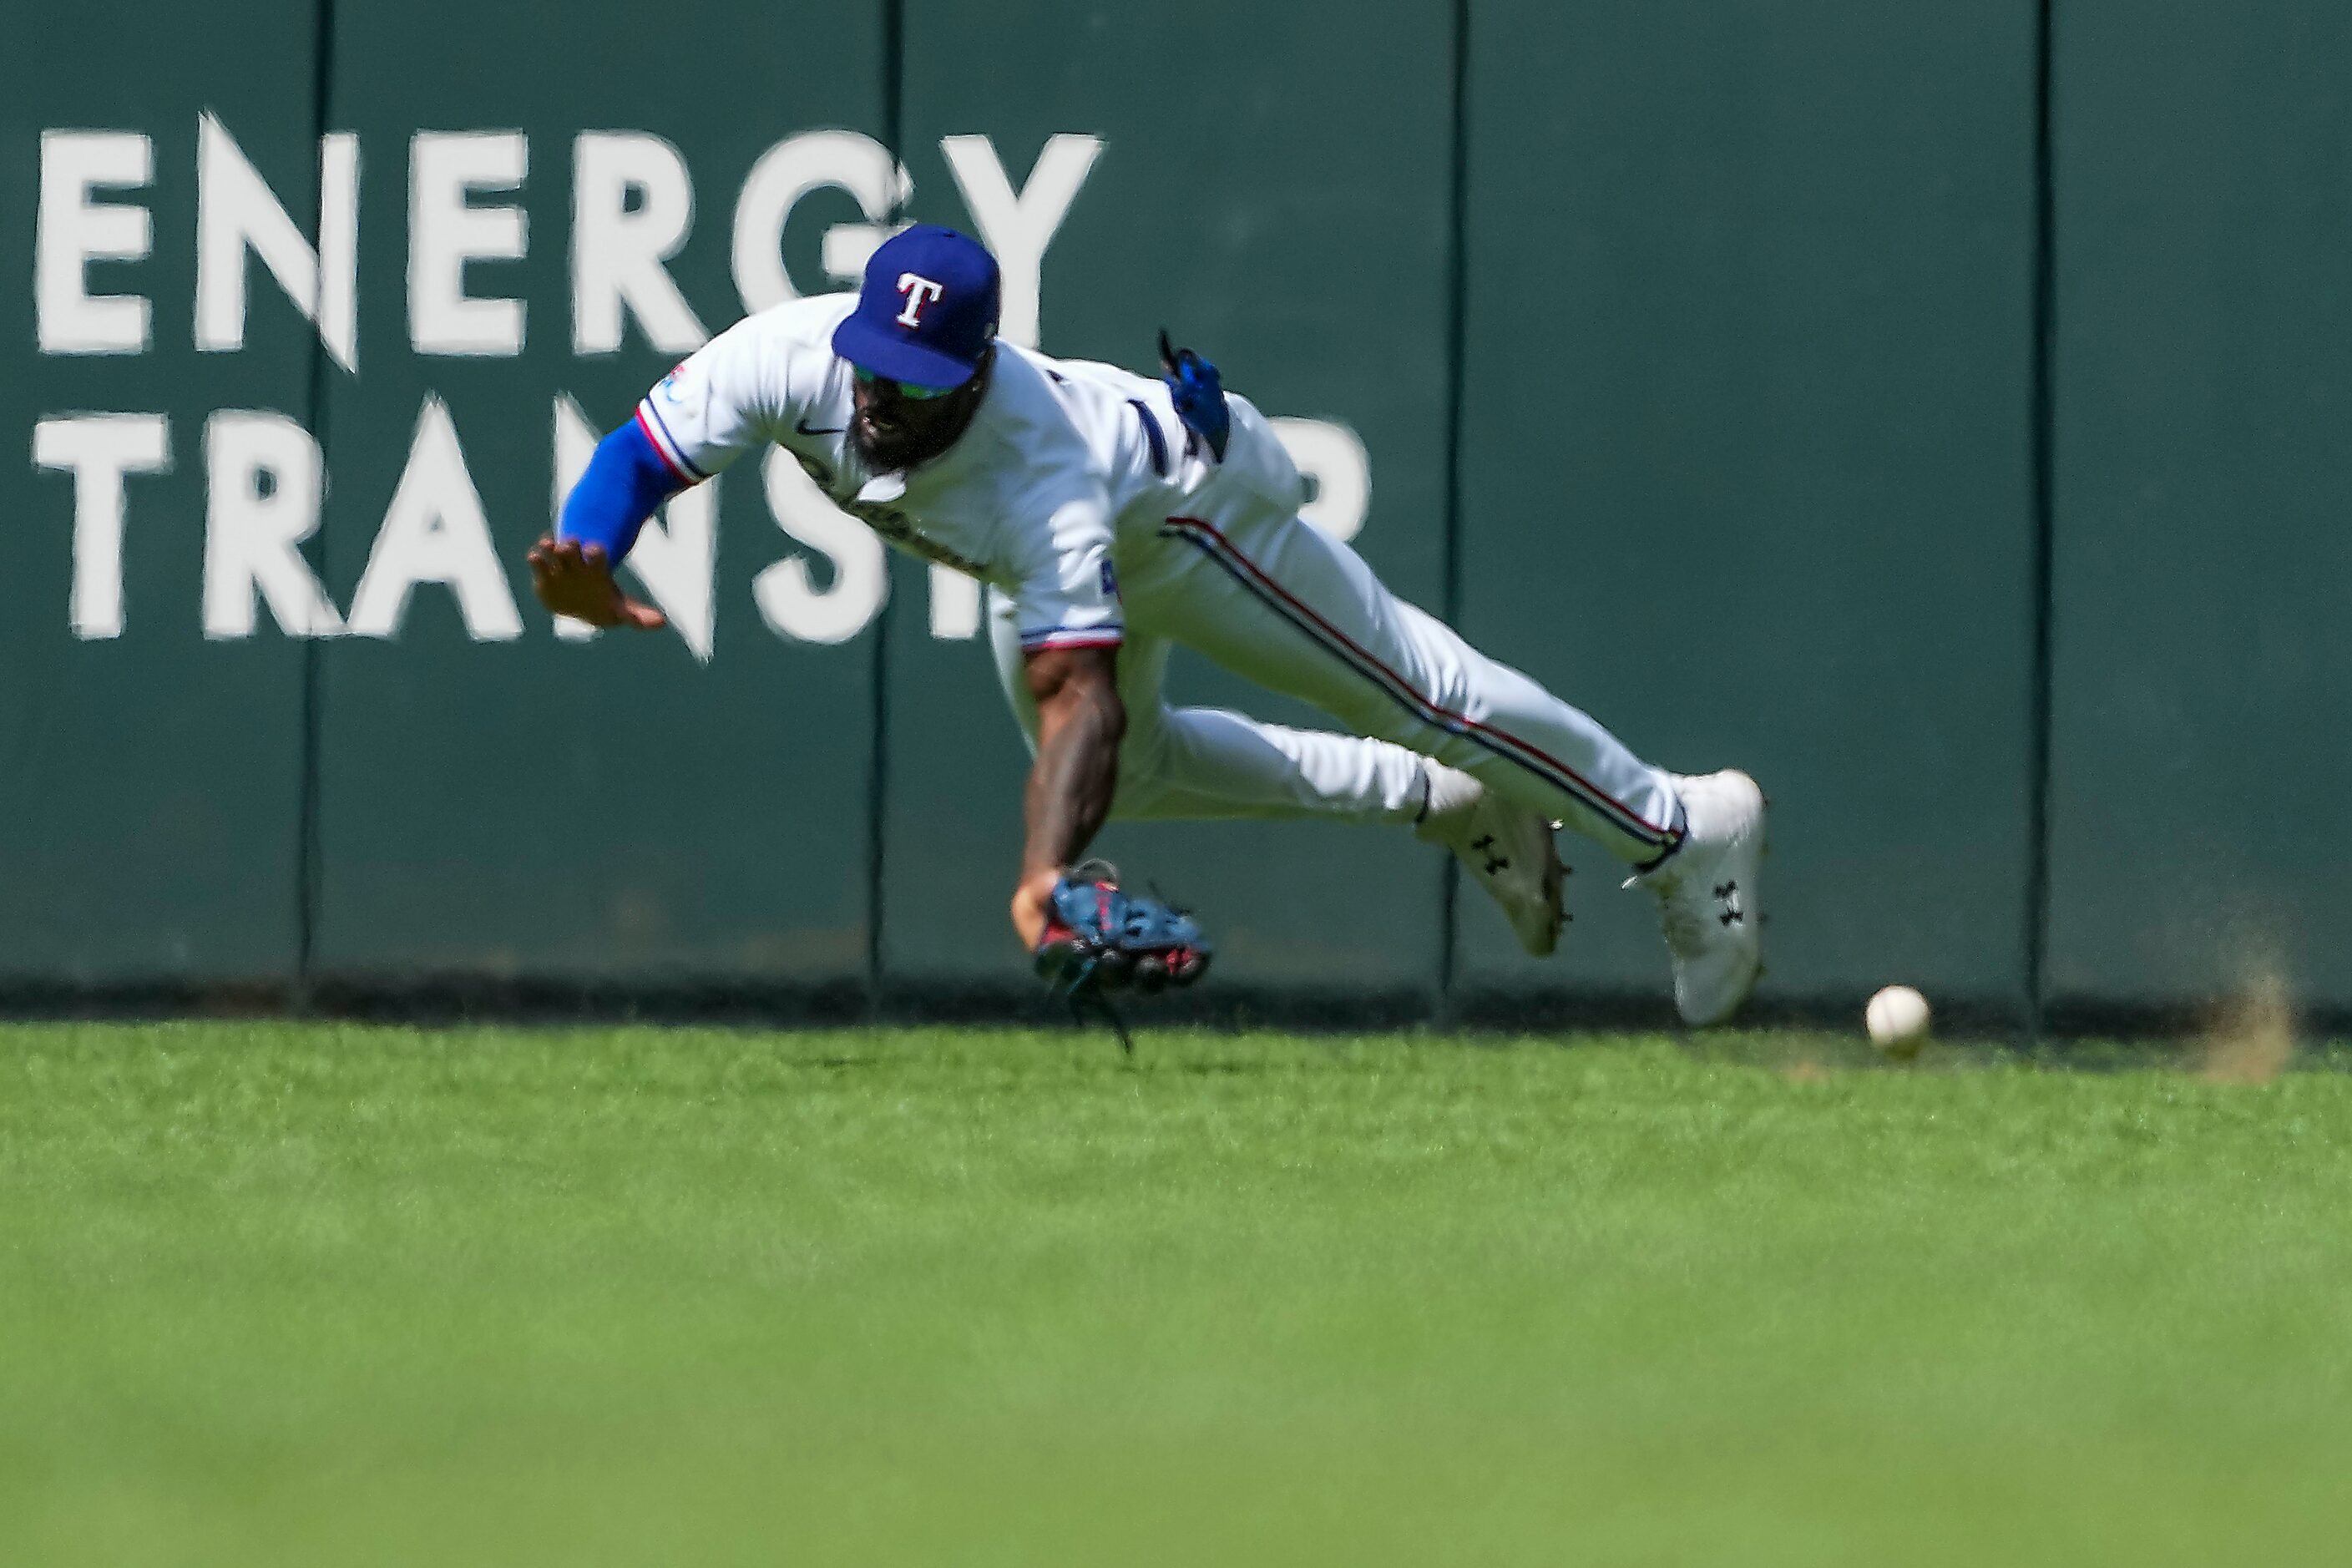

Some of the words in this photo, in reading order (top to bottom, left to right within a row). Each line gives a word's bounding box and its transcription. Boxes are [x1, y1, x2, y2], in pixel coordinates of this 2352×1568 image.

[34, 111, 1106, 372] ENERGY
[897, 272, 943, 329] T
[33, 391, 1372, 662] TRANS
